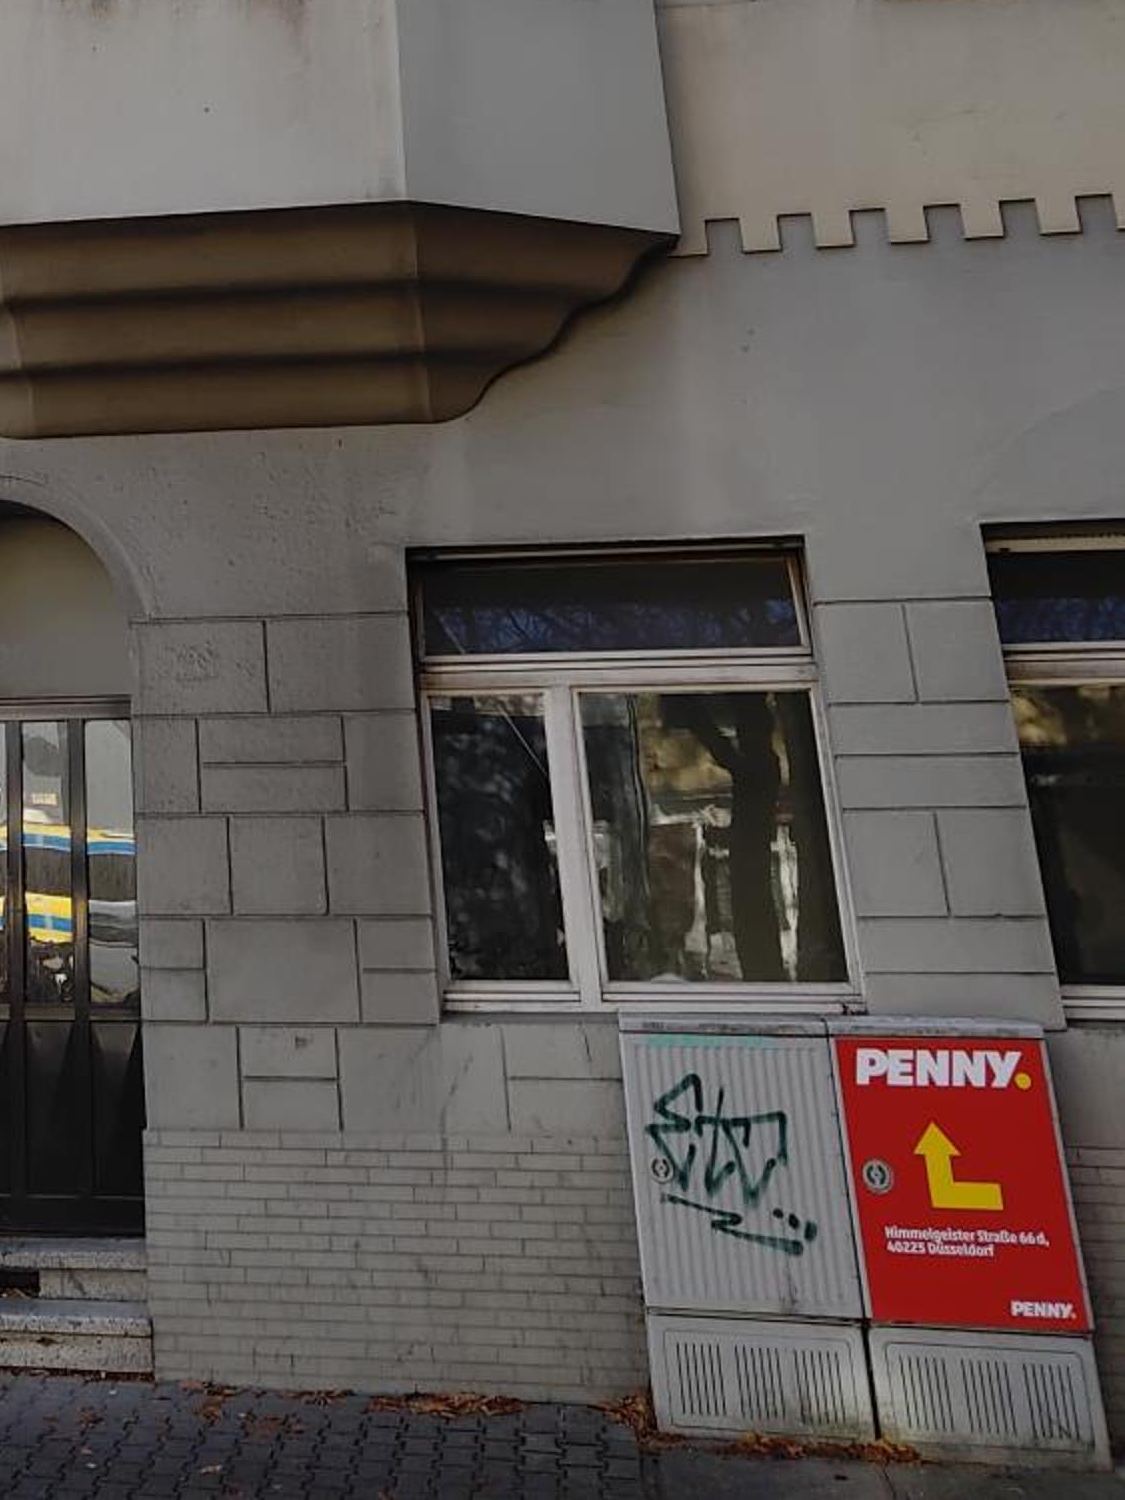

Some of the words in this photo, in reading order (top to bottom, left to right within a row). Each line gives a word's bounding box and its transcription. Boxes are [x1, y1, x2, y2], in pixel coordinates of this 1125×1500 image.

[884, 1225, 975, 1243] Himmelgeister
[976, 1229, 1017, 1244] Straße
[927, 1242, 994, 1258] Düsseldorf
